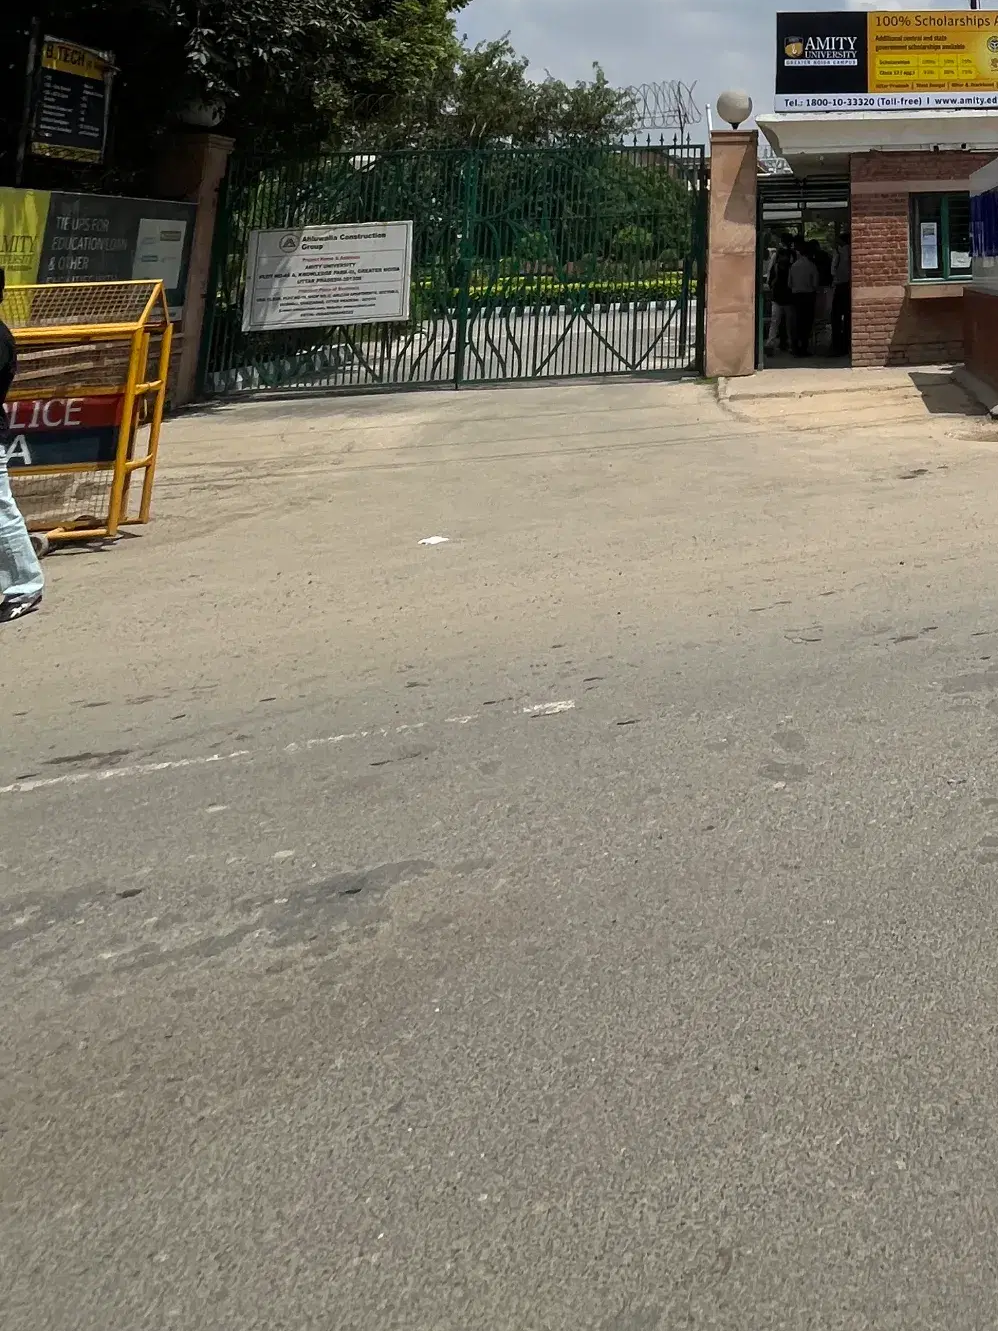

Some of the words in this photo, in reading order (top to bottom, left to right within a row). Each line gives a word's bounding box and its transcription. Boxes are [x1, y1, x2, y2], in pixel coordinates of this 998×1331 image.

[876, 16, 911, 27] 100%
[914, 15, 991, 29] Scholarships
[805, 36, 857, 51] AMITY
[804, 51, 857, 59] UNIVERSITY
[806, 97, 875, 108] 1800-10-33320
[877, 97, 922, 108] (Toll-free)
[0, 235, 40, 253] MITY
[51, 237, 103, 251] EDUCATION
[301, 234, 338, 243] Ahluwalia
[339, 232, 387, 241] Construction
[301, 243, 324, 251] Group
[58, 256, 90, 271] OTHER
